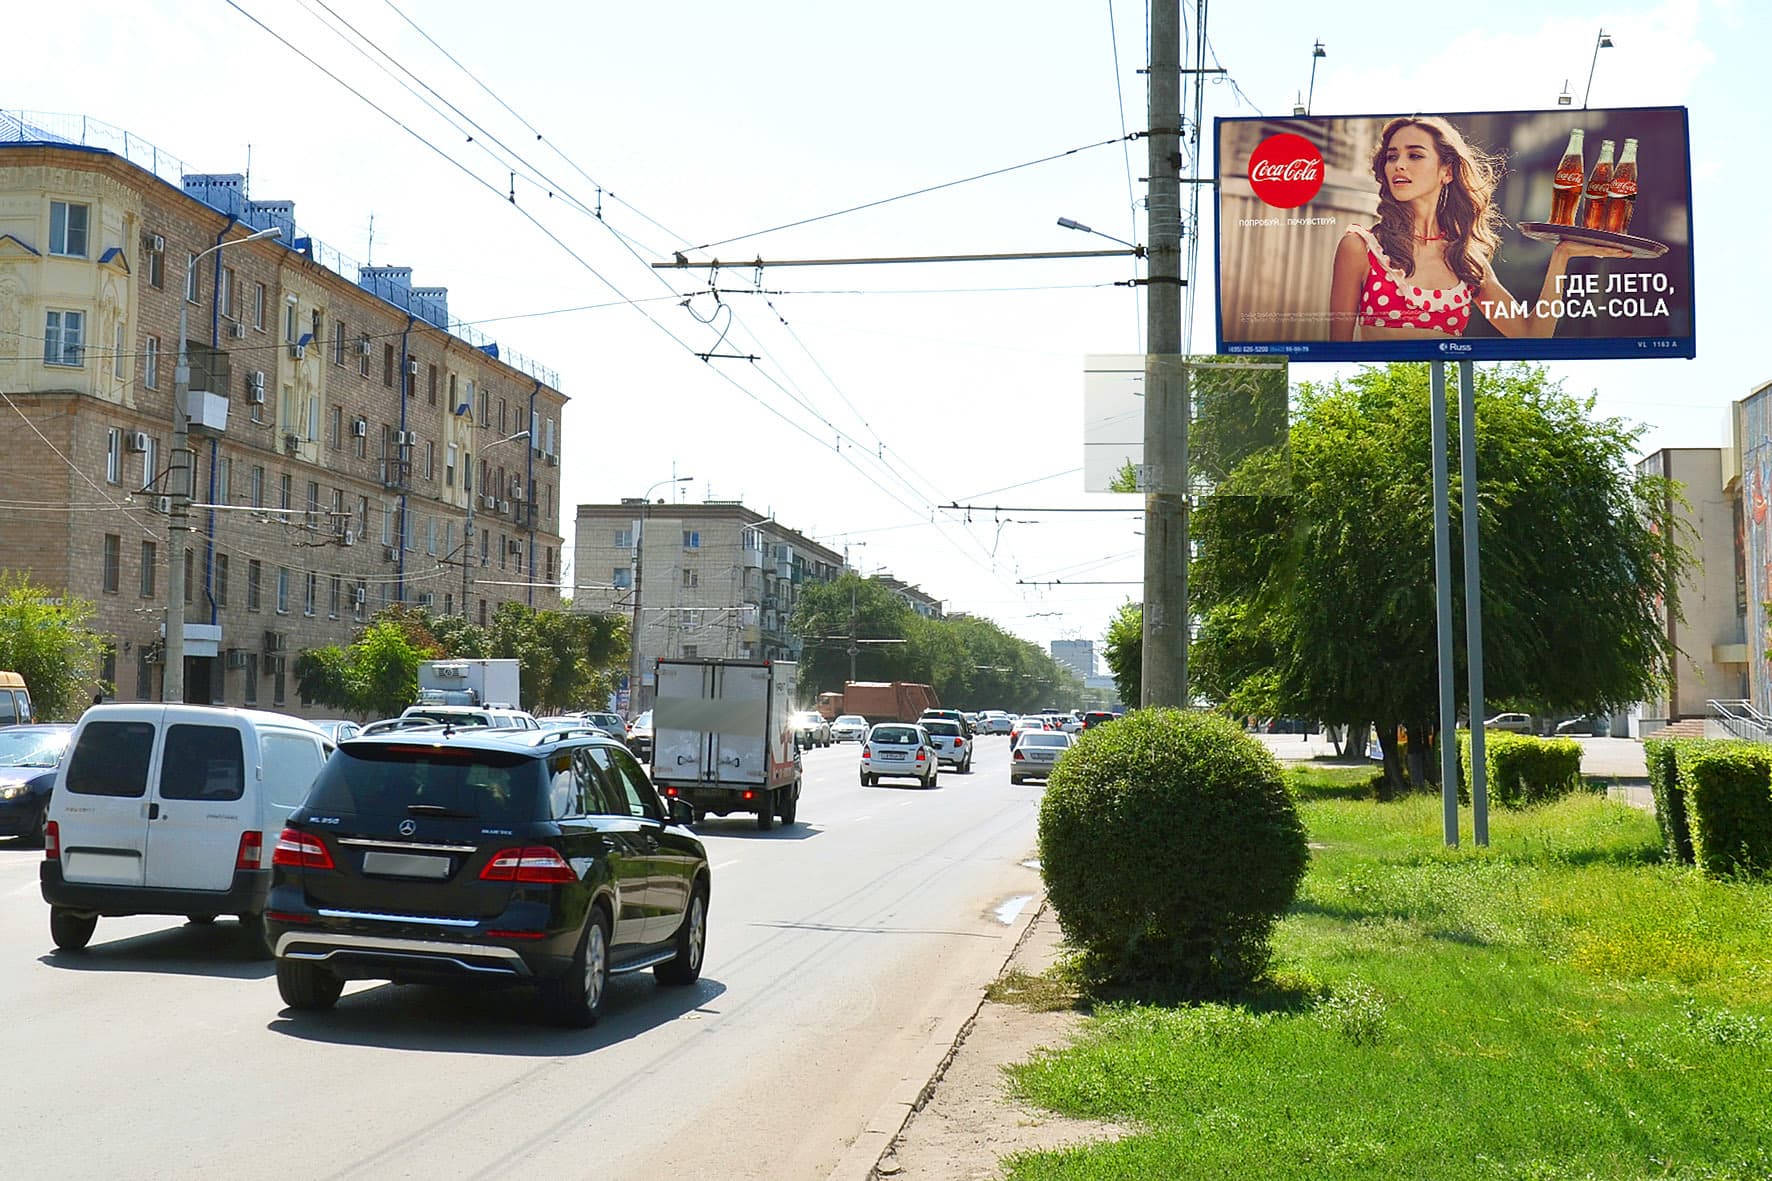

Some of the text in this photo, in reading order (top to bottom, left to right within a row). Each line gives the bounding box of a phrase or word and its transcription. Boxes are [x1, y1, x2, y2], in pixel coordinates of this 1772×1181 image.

[1555, 273, 1675, 298] ГДЕ ЛЕТО,
[1481, 297, 1670, 320] ТАМ COCA-COLA
[1449, 342, 1473, 351] Russ
